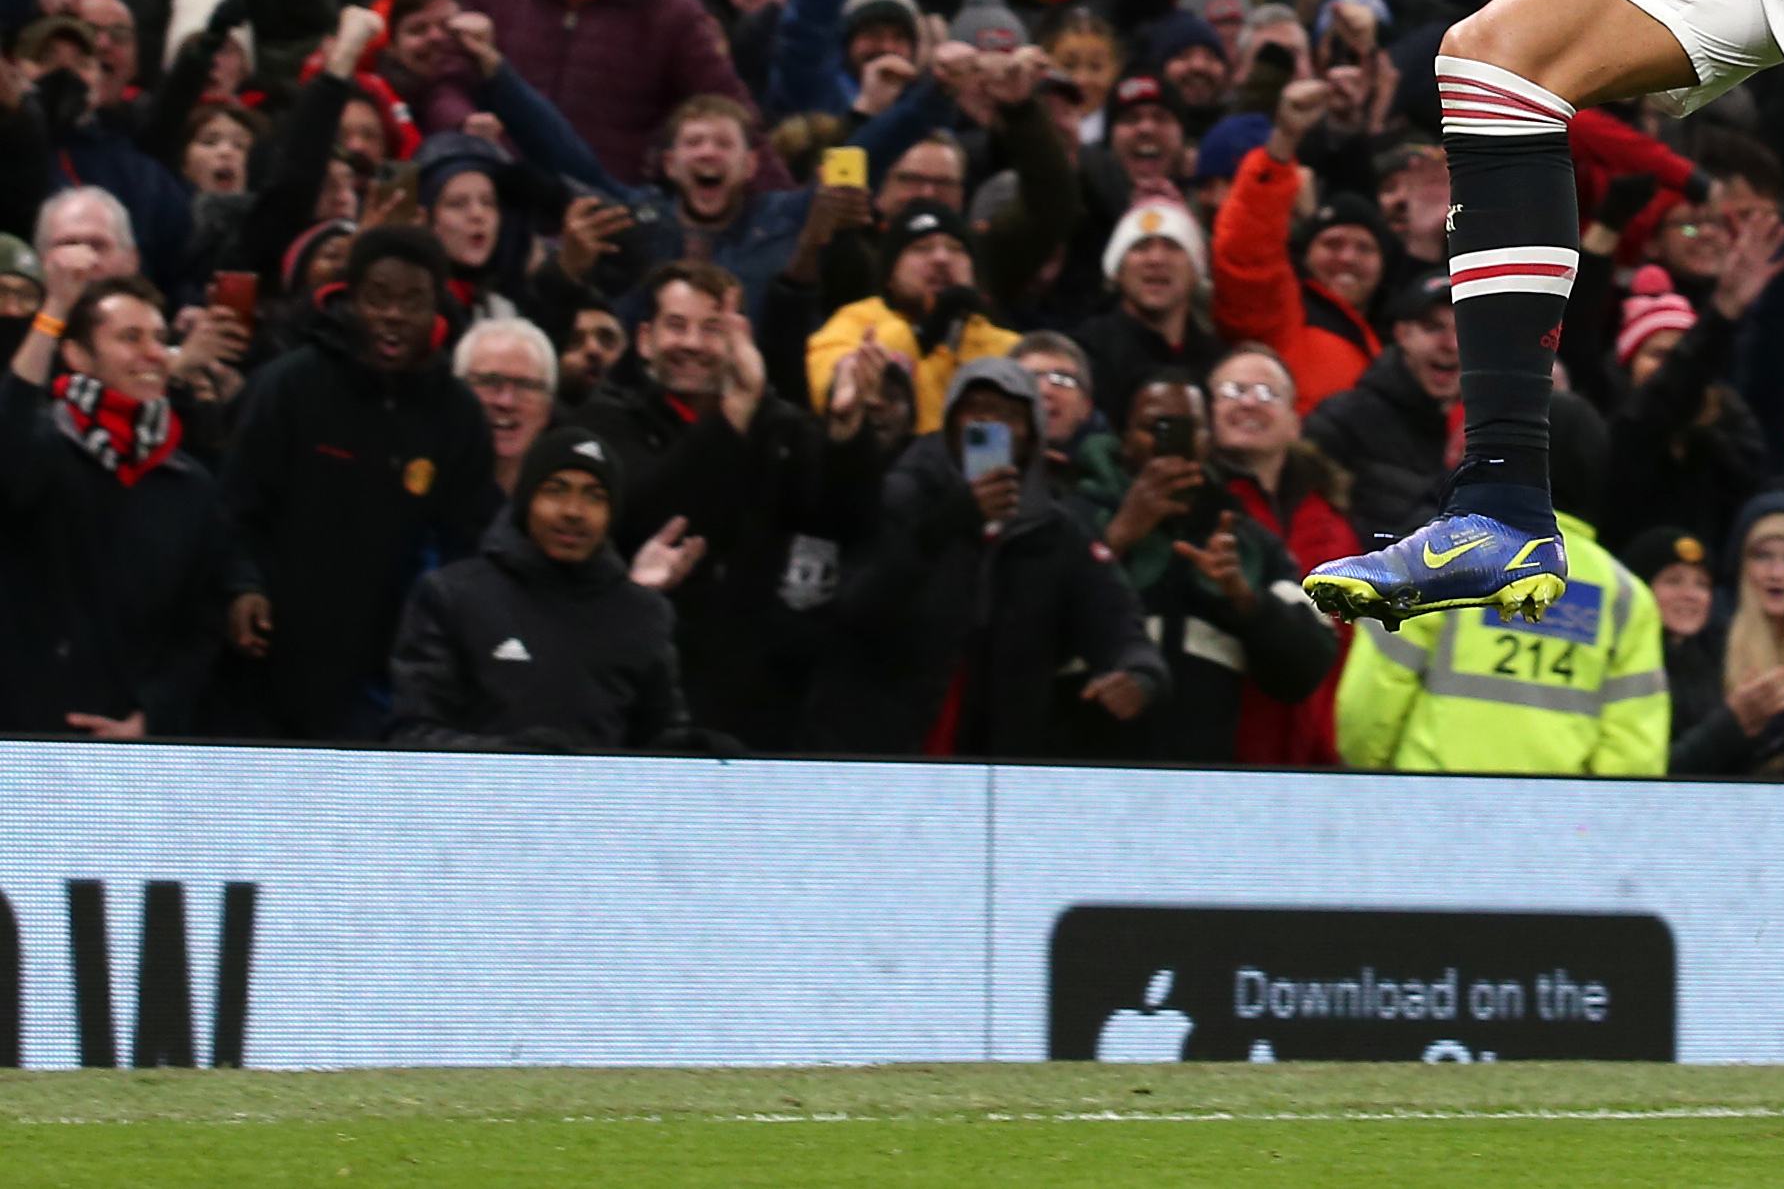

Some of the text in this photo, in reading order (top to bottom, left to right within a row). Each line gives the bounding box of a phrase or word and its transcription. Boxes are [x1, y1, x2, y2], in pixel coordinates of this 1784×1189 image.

[1493, 634, 1577, 684] 214
[0, 880, 259, 1068] W
[1234, 965, 1610, 1022] Download on the
